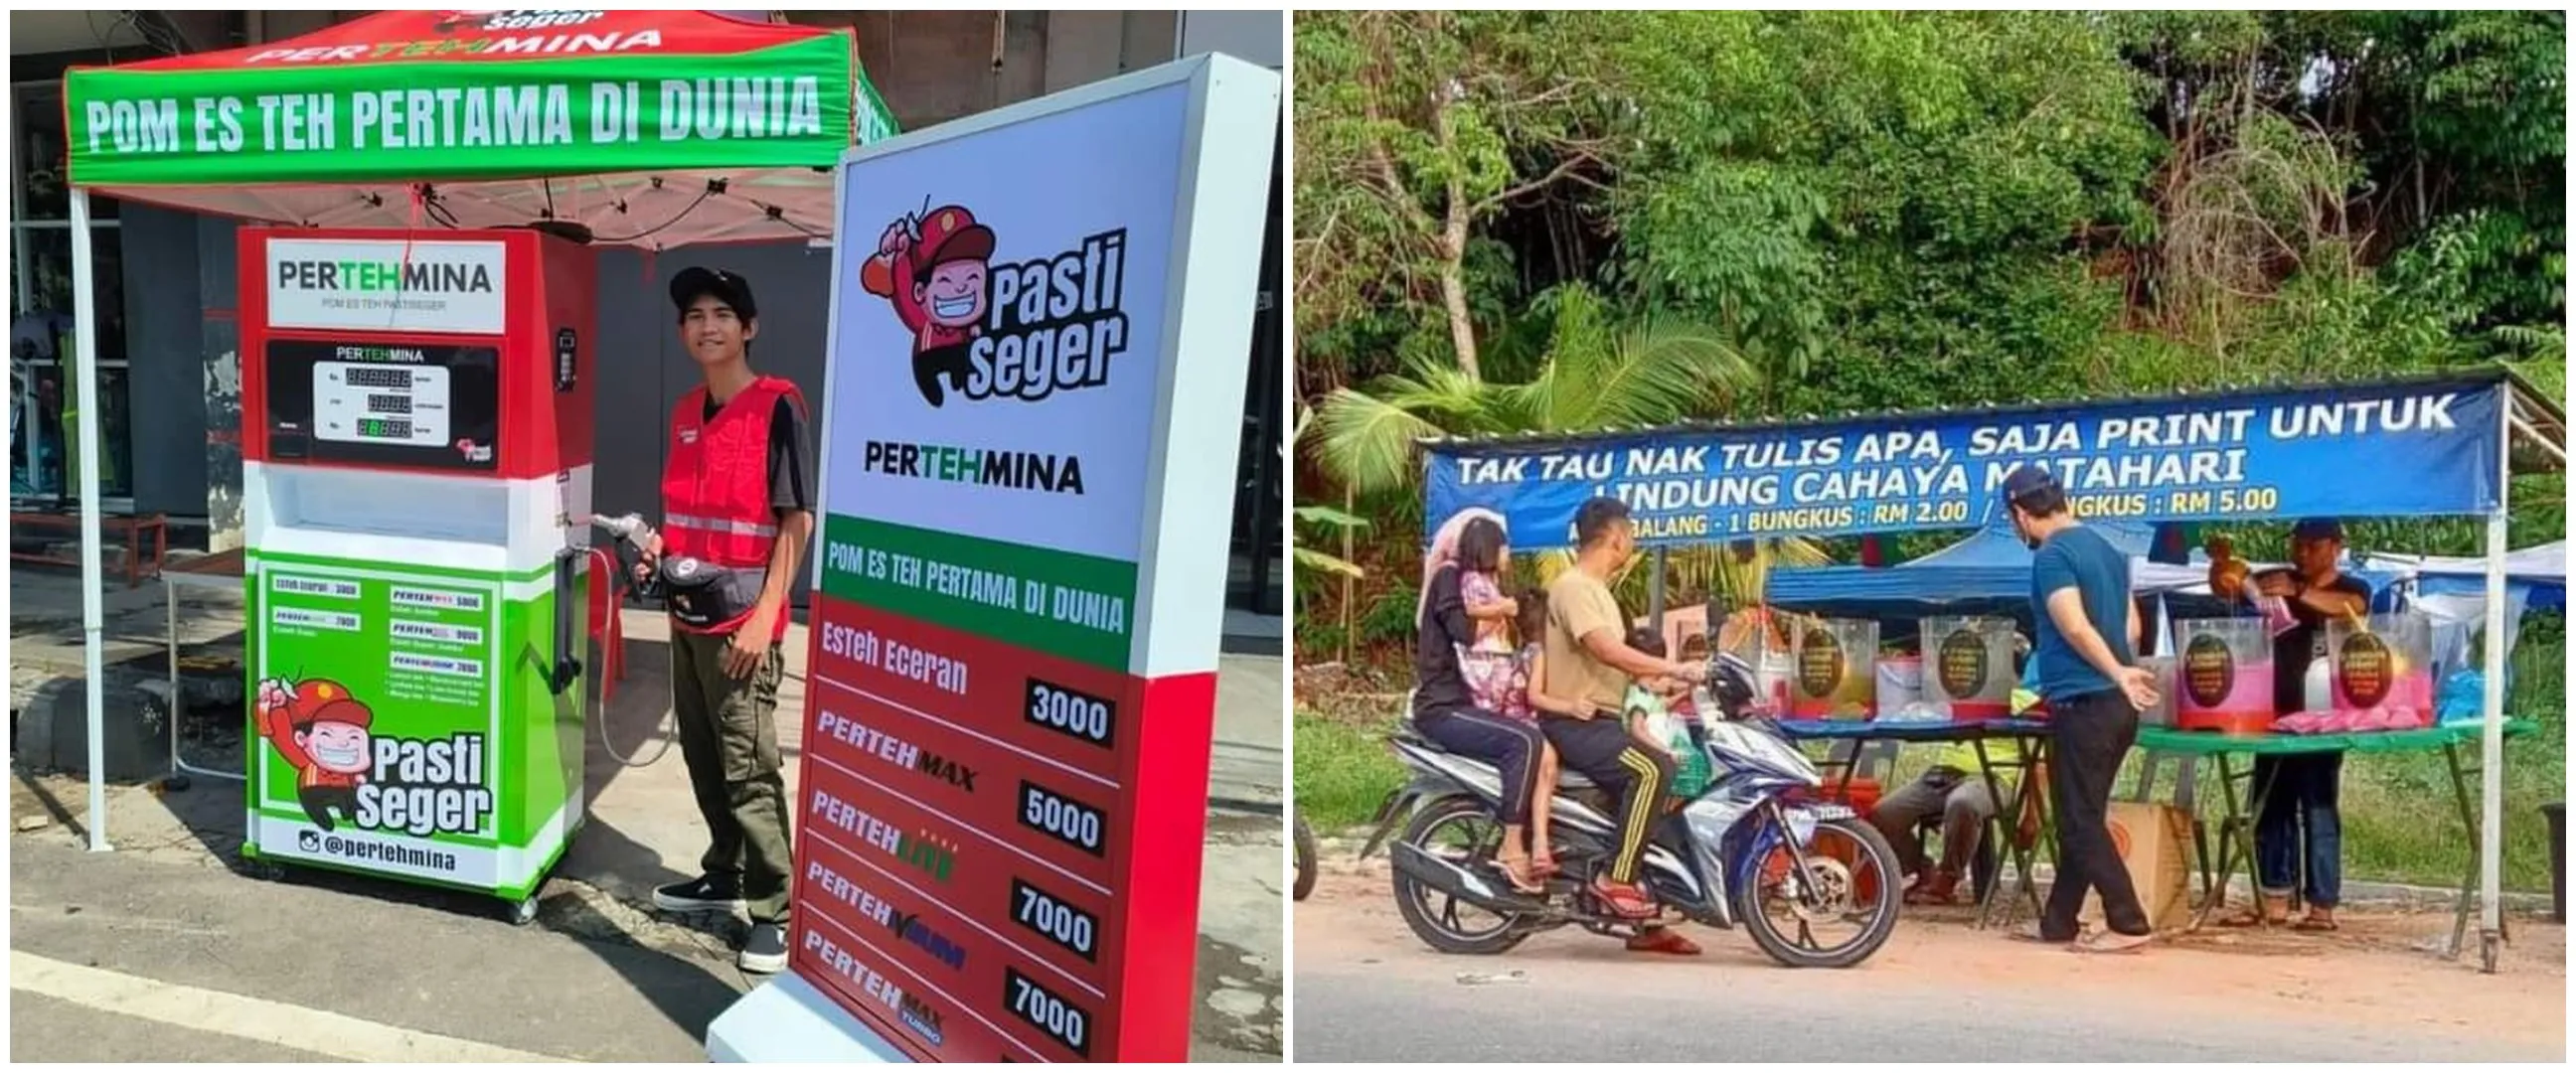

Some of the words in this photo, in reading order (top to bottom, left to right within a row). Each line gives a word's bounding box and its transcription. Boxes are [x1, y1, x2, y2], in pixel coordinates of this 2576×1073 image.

[244, 29, 662, 64] PERTEHMINA
[85, 97, 178, 153] POM
[197, 95, 243, 152] ES
[261, 93, 336, 151] TEH
[352, 84, 572, 149] PERTAMA
[591, 81, 639, 144] DI
[660, 76, 821, 141] DUNIA
[278, 261, 493, 294] PERTEHMINA
[992, 235, 1122, 330] Pasti
[336, 346, 425, 363] PERTEHMINA
[967, 315, 1124, 395] seger
[1459, 456, 1527, 485] TAK
[1539, 451, 1612, 480] TAU
[1625, 446, 1709, 476] NAK
[1720, 437, 1841, 471] TULIS
[1853, 430, 1952, 467] APA,
[1969, 423, 2082, 456] SAJA
[2096, 408, 2256, 449] PRINT
[2267, 392, 2459, 439] UNTUK
[864, 440, 1084, 496] PERTEHMINA
[1793, 463, 1969, 502] CAHAYA
[1728, 514, 1739, 534] 1
[1747, 508, 1852, 534] BUNGKUS
[1873, 504, 1909, 527] RM
[1915, 501, 1969, 524] 2.00
[2171, 492, 2210, 514] RM
[2219, 487, 2277, 512] 5.00
[828, 540, 864, 575] POM
[867, 551, 887, 580] ES
[892, 553, 921, 587] TEH
[926, 560, 1018, 610] PERTAMA
[1024, 578, 1046, 617] DI
[1053, 586, 1124, 635] DUNIA
[1032, 685, 1109, 740] 3000
[375, 735, 484, 785] Pasti
[818, 709, 979, 793] PERTEHMAX
[356, 785, 492, 836] seger
[1026, 788, 1099, 847] 5000
[324, 837, 456, 870] @pertehmina
[1020, 886, 1092, 952] 7000
[1016, 977, 1083, 1047] 7000
